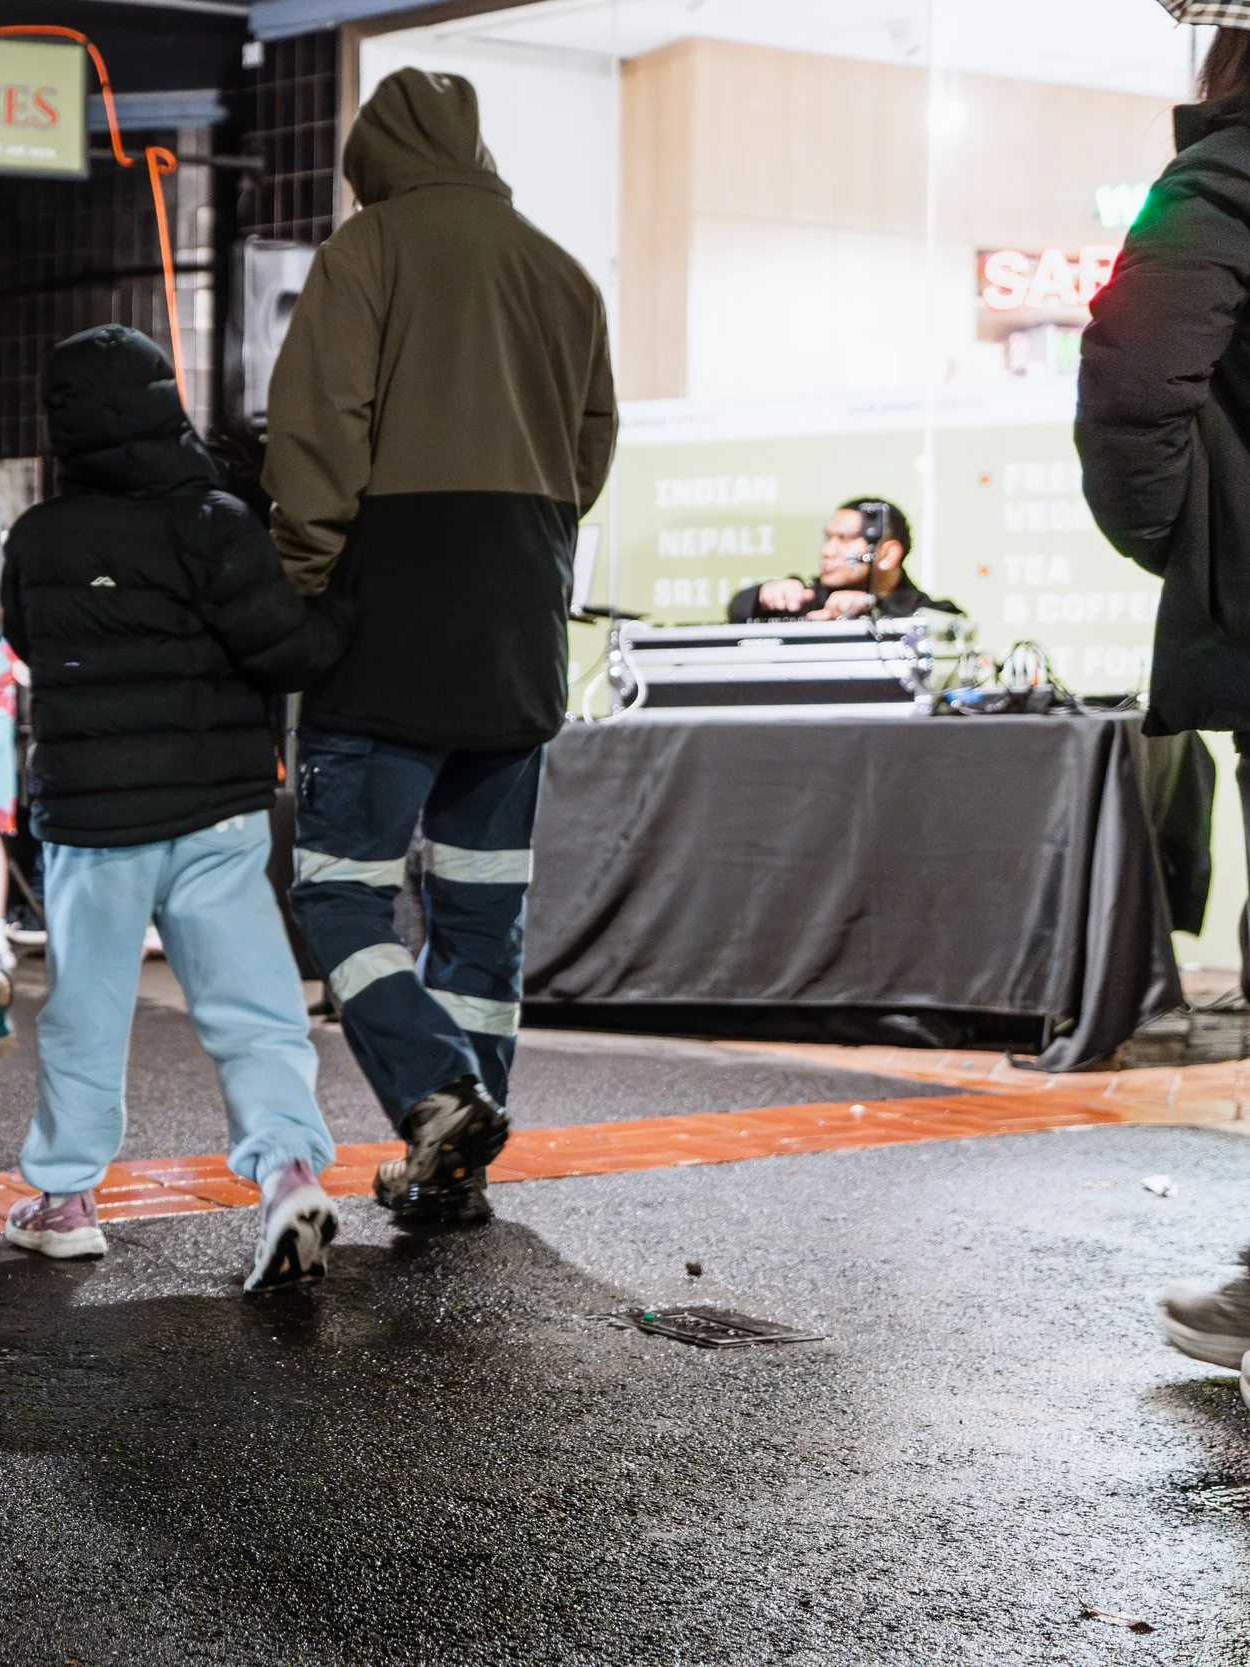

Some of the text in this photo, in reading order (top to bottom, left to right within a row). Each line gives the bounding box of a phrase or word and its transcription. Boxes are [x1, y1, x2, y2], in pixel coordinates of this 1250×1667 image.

[654, 475, 778, 508] INDIAN
[658, 525, 774, 557] NEPALI
[1003, 554, 1070, 585] TEA
[653, 577, 710, 608] SRI
